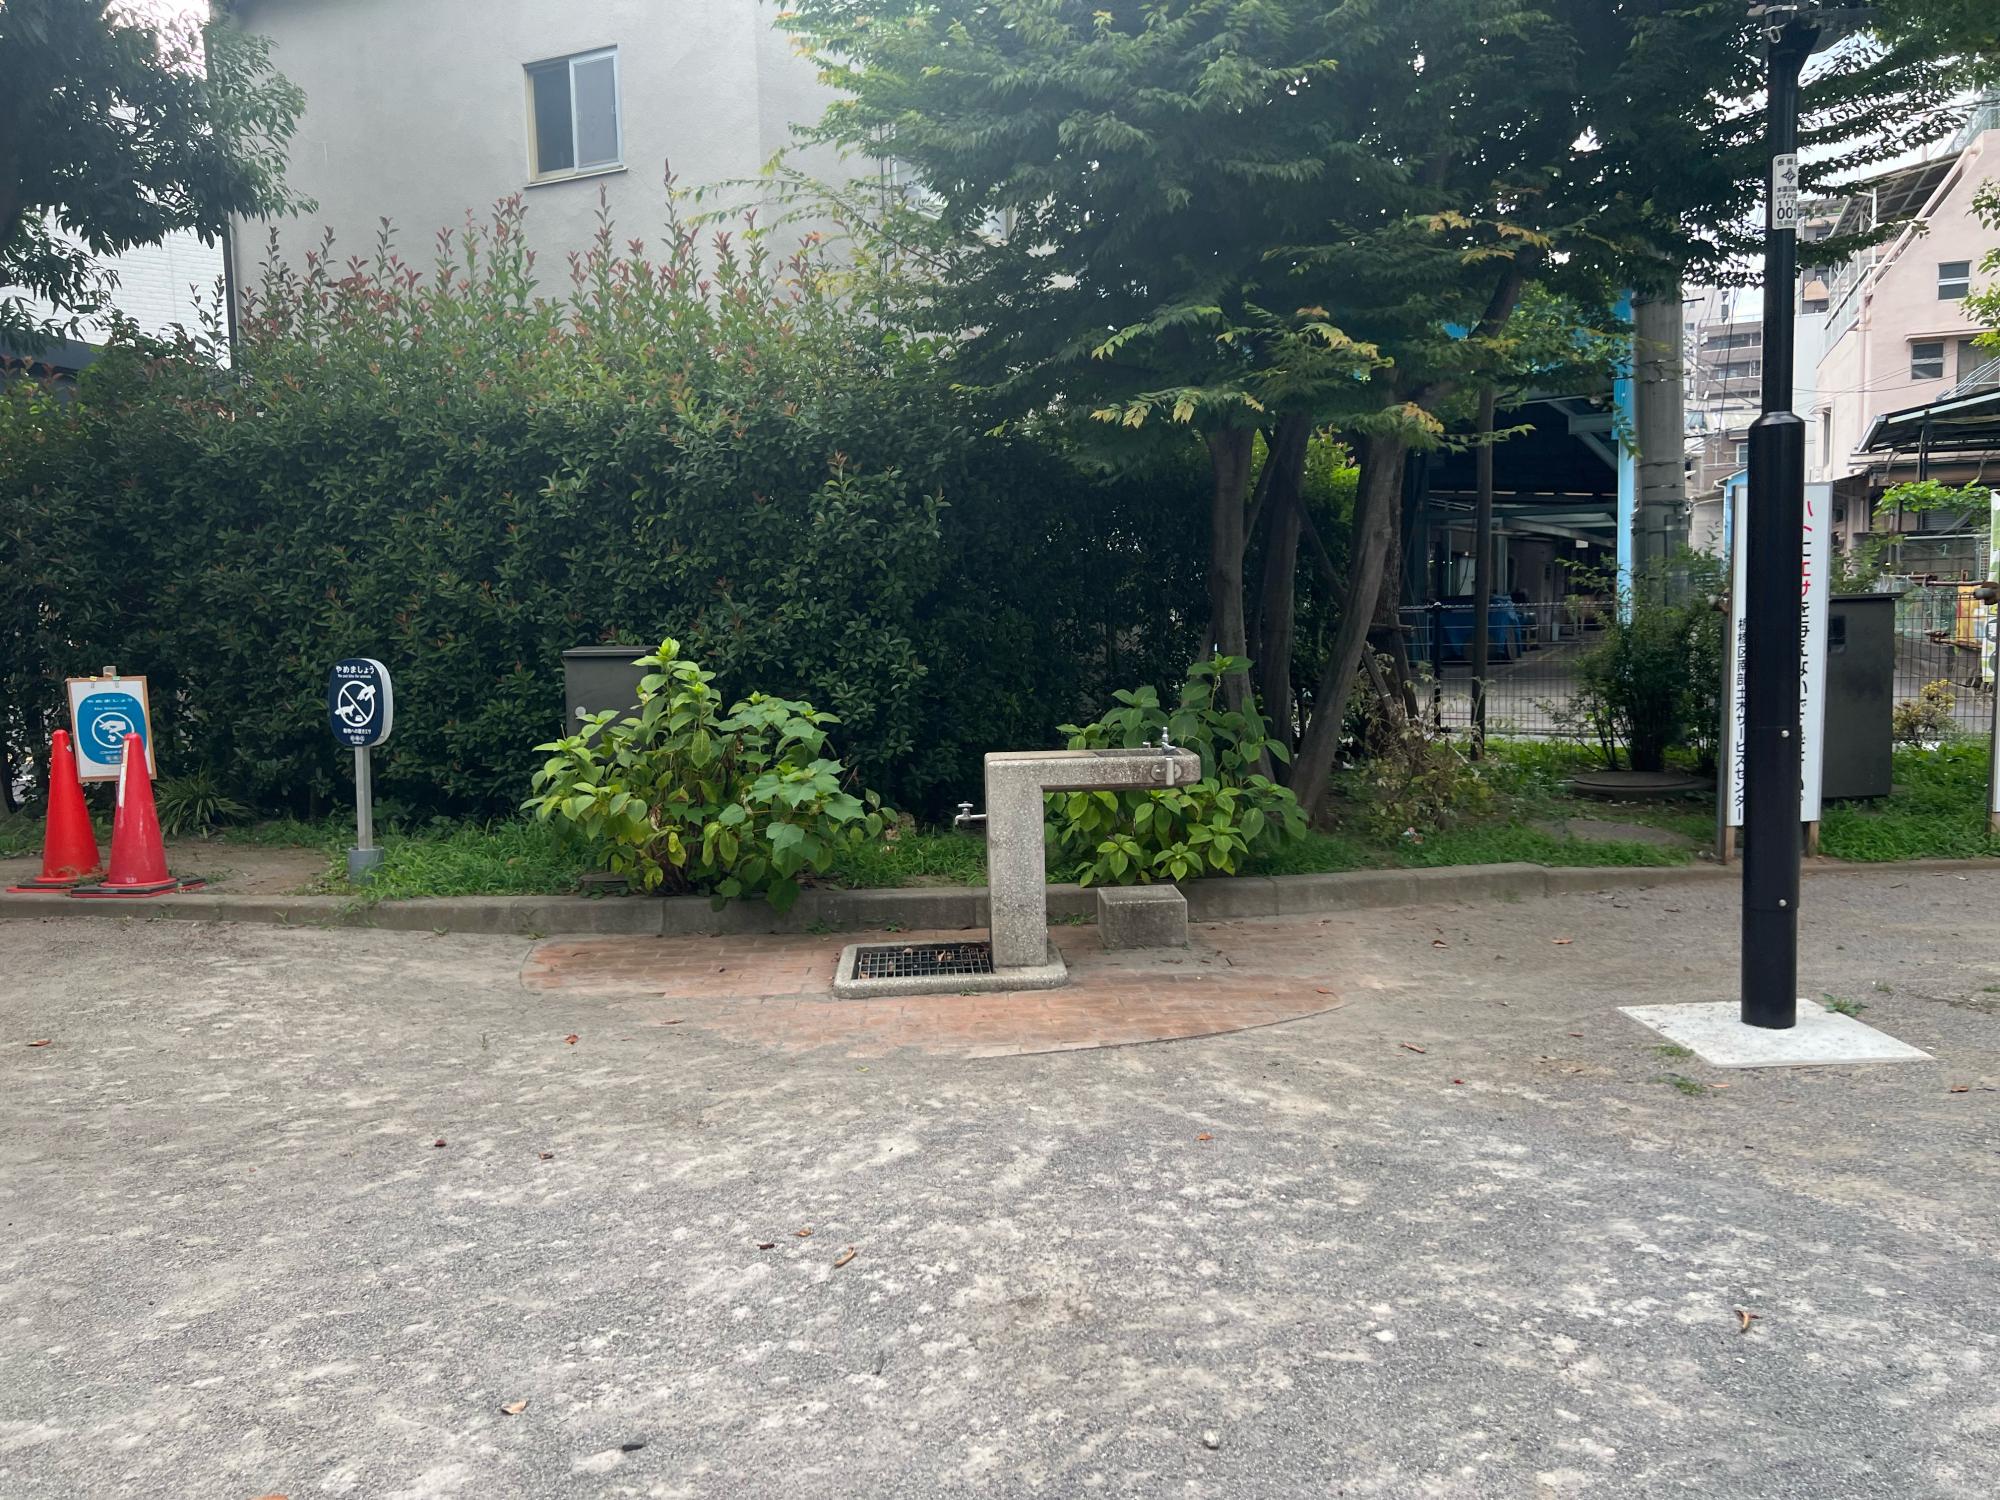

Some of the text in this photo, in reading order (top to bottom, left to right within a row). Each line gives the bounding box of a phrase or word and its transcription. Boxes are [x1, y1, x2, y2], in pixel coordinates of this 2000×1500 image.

[335, 665, 375, 674] やめましょう
